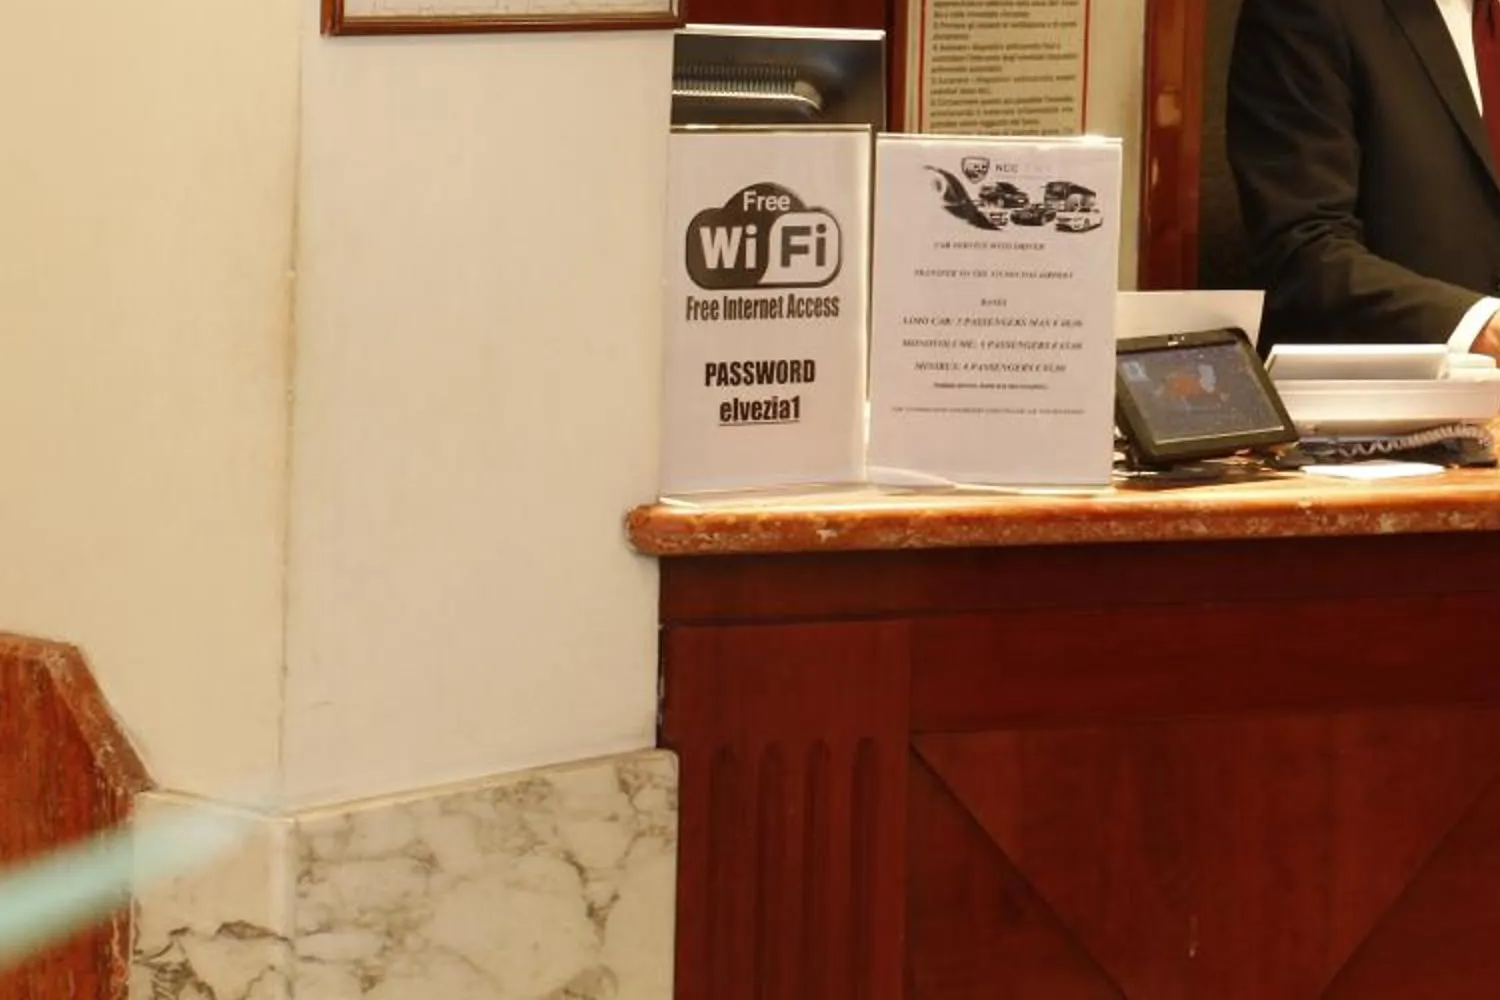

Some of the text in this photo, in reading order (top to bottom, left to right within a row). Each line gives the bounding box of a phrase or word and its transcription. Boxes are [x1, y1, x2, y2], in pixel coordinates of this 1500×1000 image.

[742, 190, 792, 212] Free
[686, 293, 840, 321] Free Internet Access
[704, 359, 816, 387] PASSWORD
[719, 395, 800, 422] elvezia1
